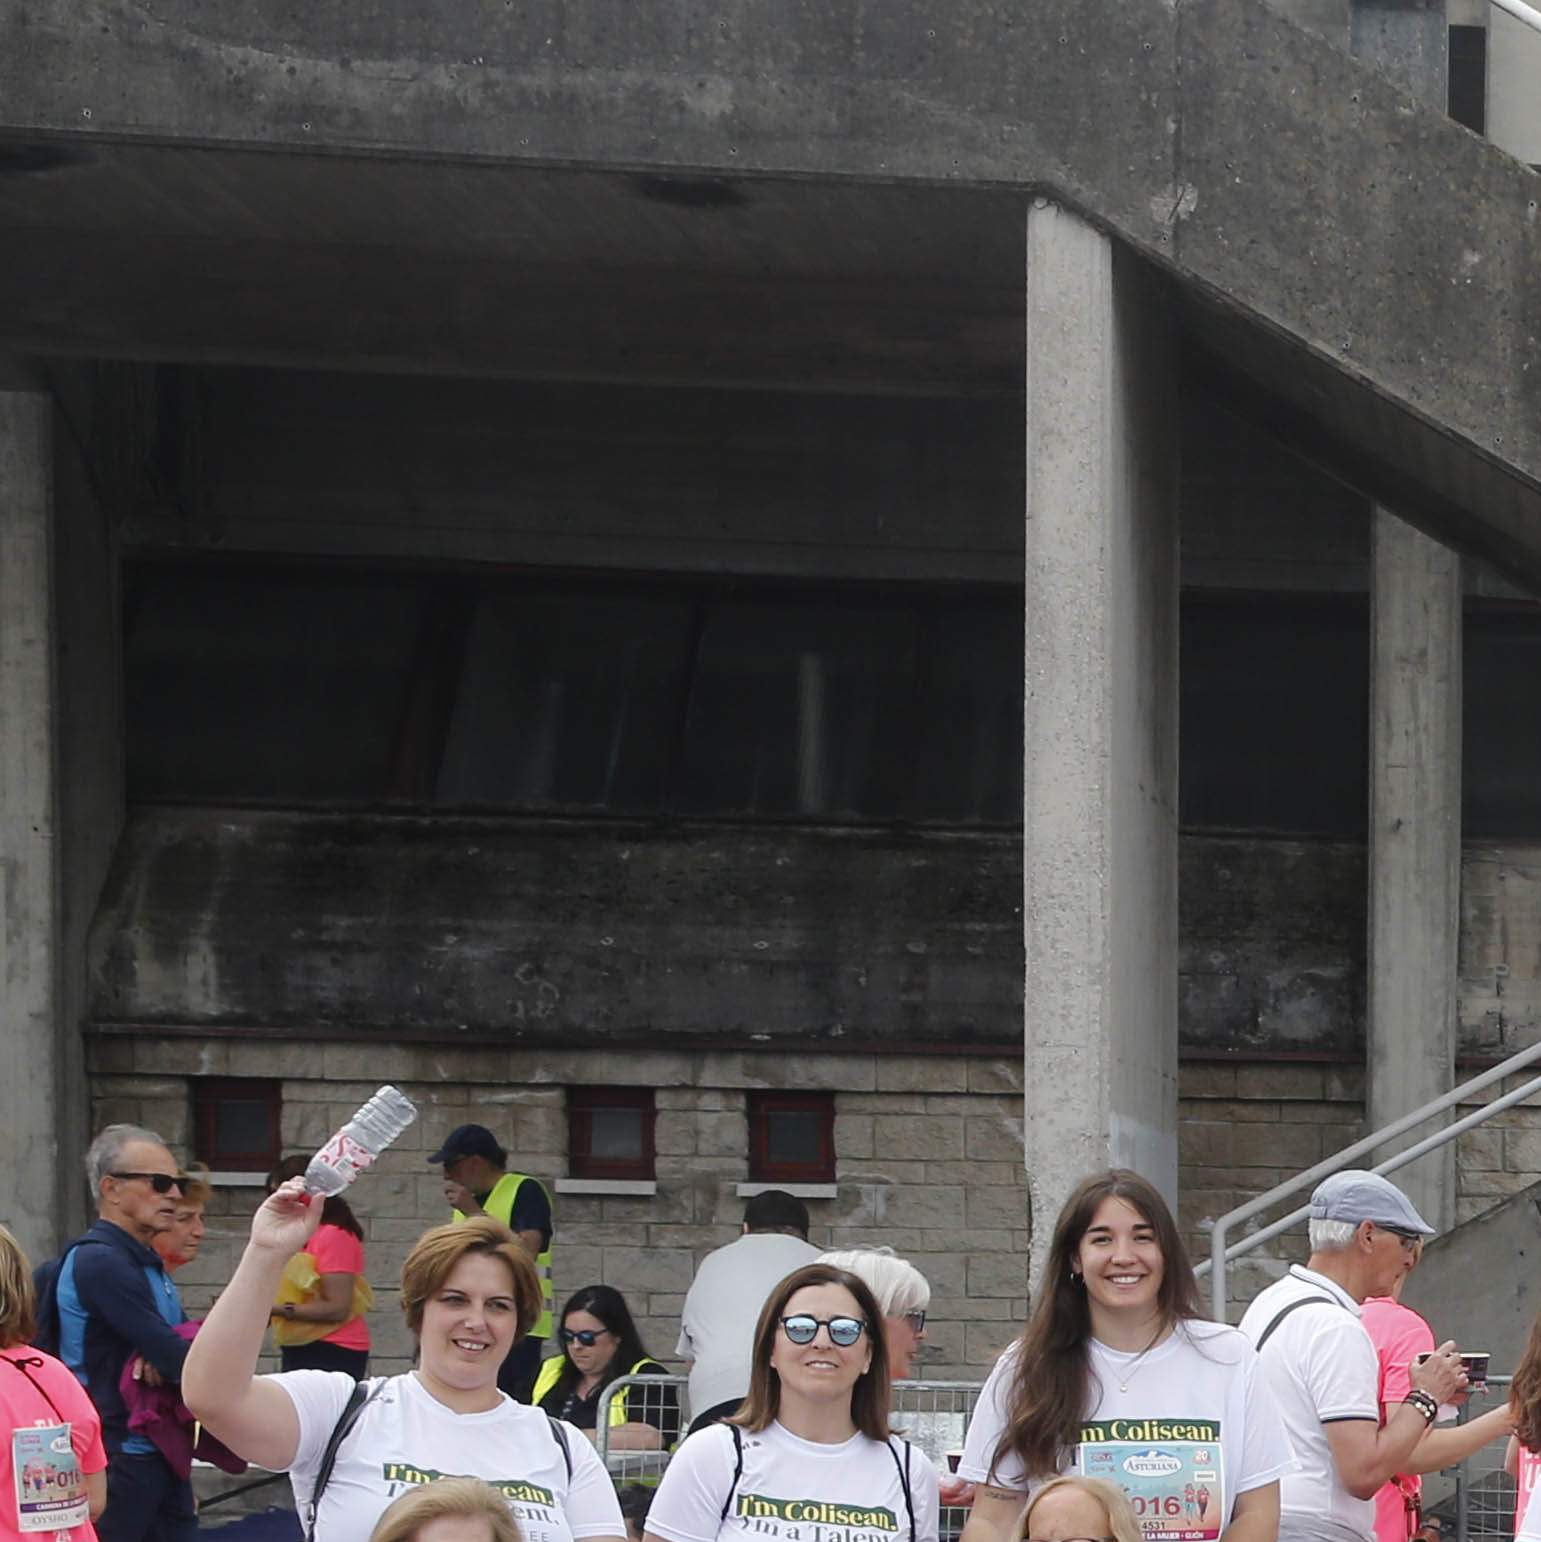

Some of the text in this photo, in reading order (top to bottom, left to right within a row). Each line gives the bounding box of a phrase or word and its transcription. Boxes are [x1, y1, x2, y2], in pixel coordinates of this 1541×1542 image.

[1111, 1421, 1220, 1441] Colisean.
[1126, 1461, 1178, 1472] ASTURIANA
[32, 1513, 69, 1525] OYSHO
[741, 1496, 897, 1531] I'm Colisean.
[786, 1523, 801, 1541] a
[1142, 1521, 1166, 1530] 4531
